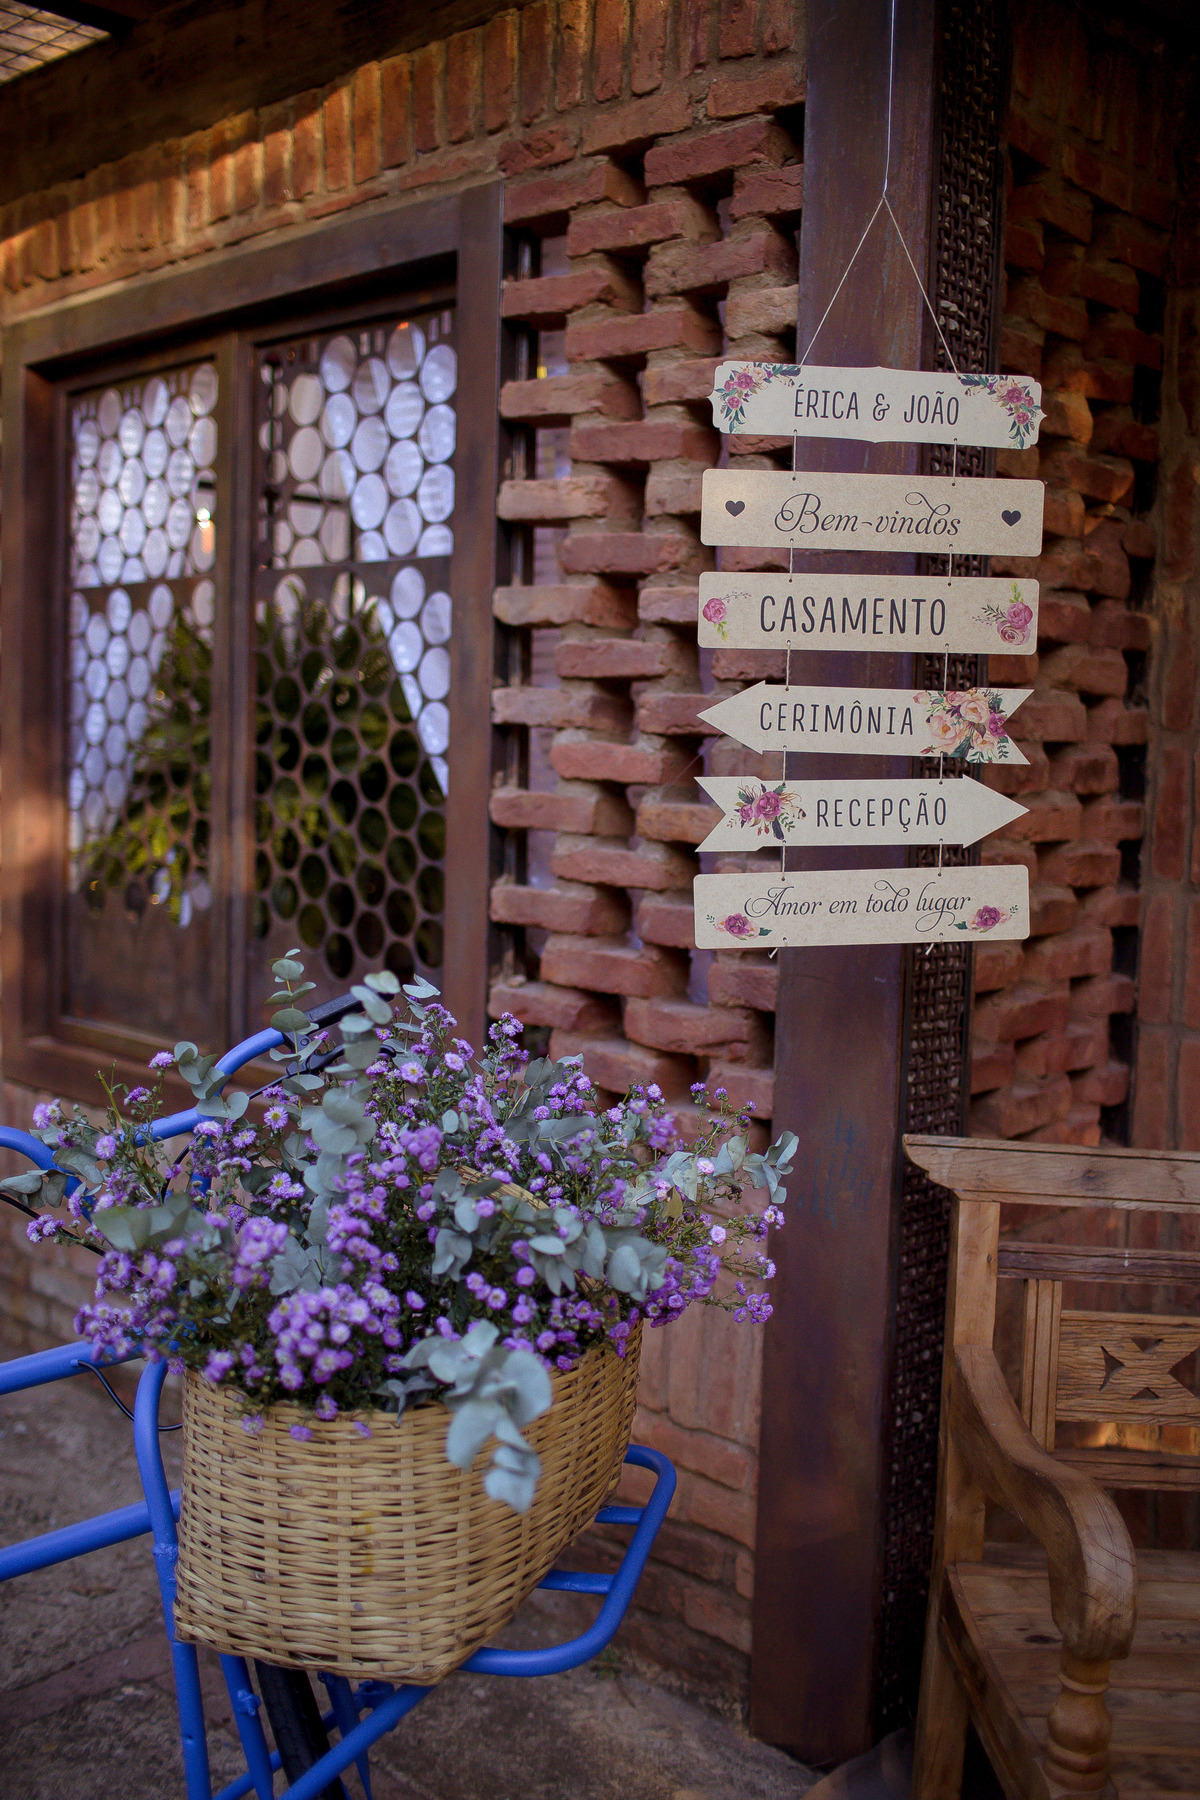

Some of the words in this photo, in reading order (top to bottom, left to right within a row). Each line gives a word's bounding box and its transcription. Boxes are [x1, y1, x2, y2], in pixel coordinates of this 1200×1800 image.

[794, 384, 860, 420] ÉRICA
[872, 393, 891, 421] &
[904, 391, 960, 426] JOÃO
[774, 491, 961, 536] Bem-vindos
[760, 595, 947, 636] CASAMENTO
[760, 700, 914, 736] CERIMÔNIA
[816, 792, 948, 833] RECEPÇÃO
[744, 886, 823, 918] Amor
[828, 899, 858, 914] em
[865, 879, 911, 913] todo
[914, 881, 971, 933] lugar
